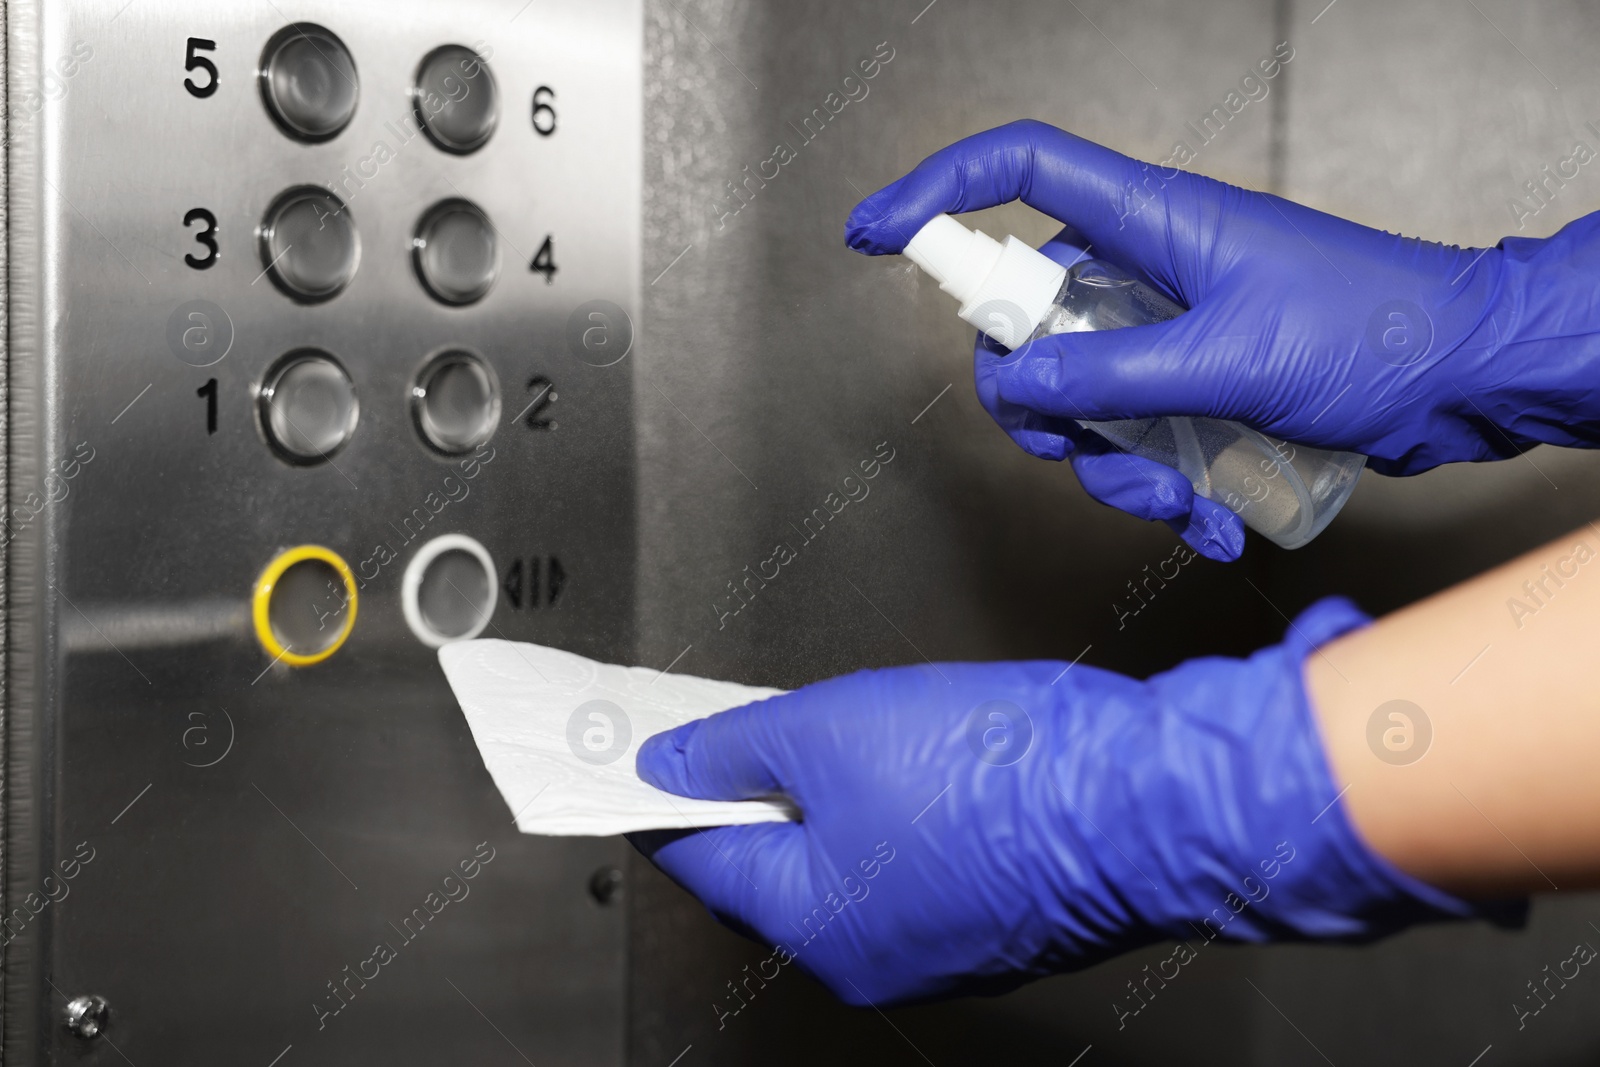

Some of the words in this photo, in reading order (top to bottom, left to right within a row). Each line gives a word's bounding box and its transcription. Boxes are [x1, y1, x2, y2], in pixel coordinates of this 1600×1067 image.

[184, 37, 219, 99] 5
[531, 84, 557, 137] 6
[183, 208, 219, 270] 3
[529, 234, 558, 286] 4
[197, 377, 218, 435] 1
[526, 374, 556, 432] 2
